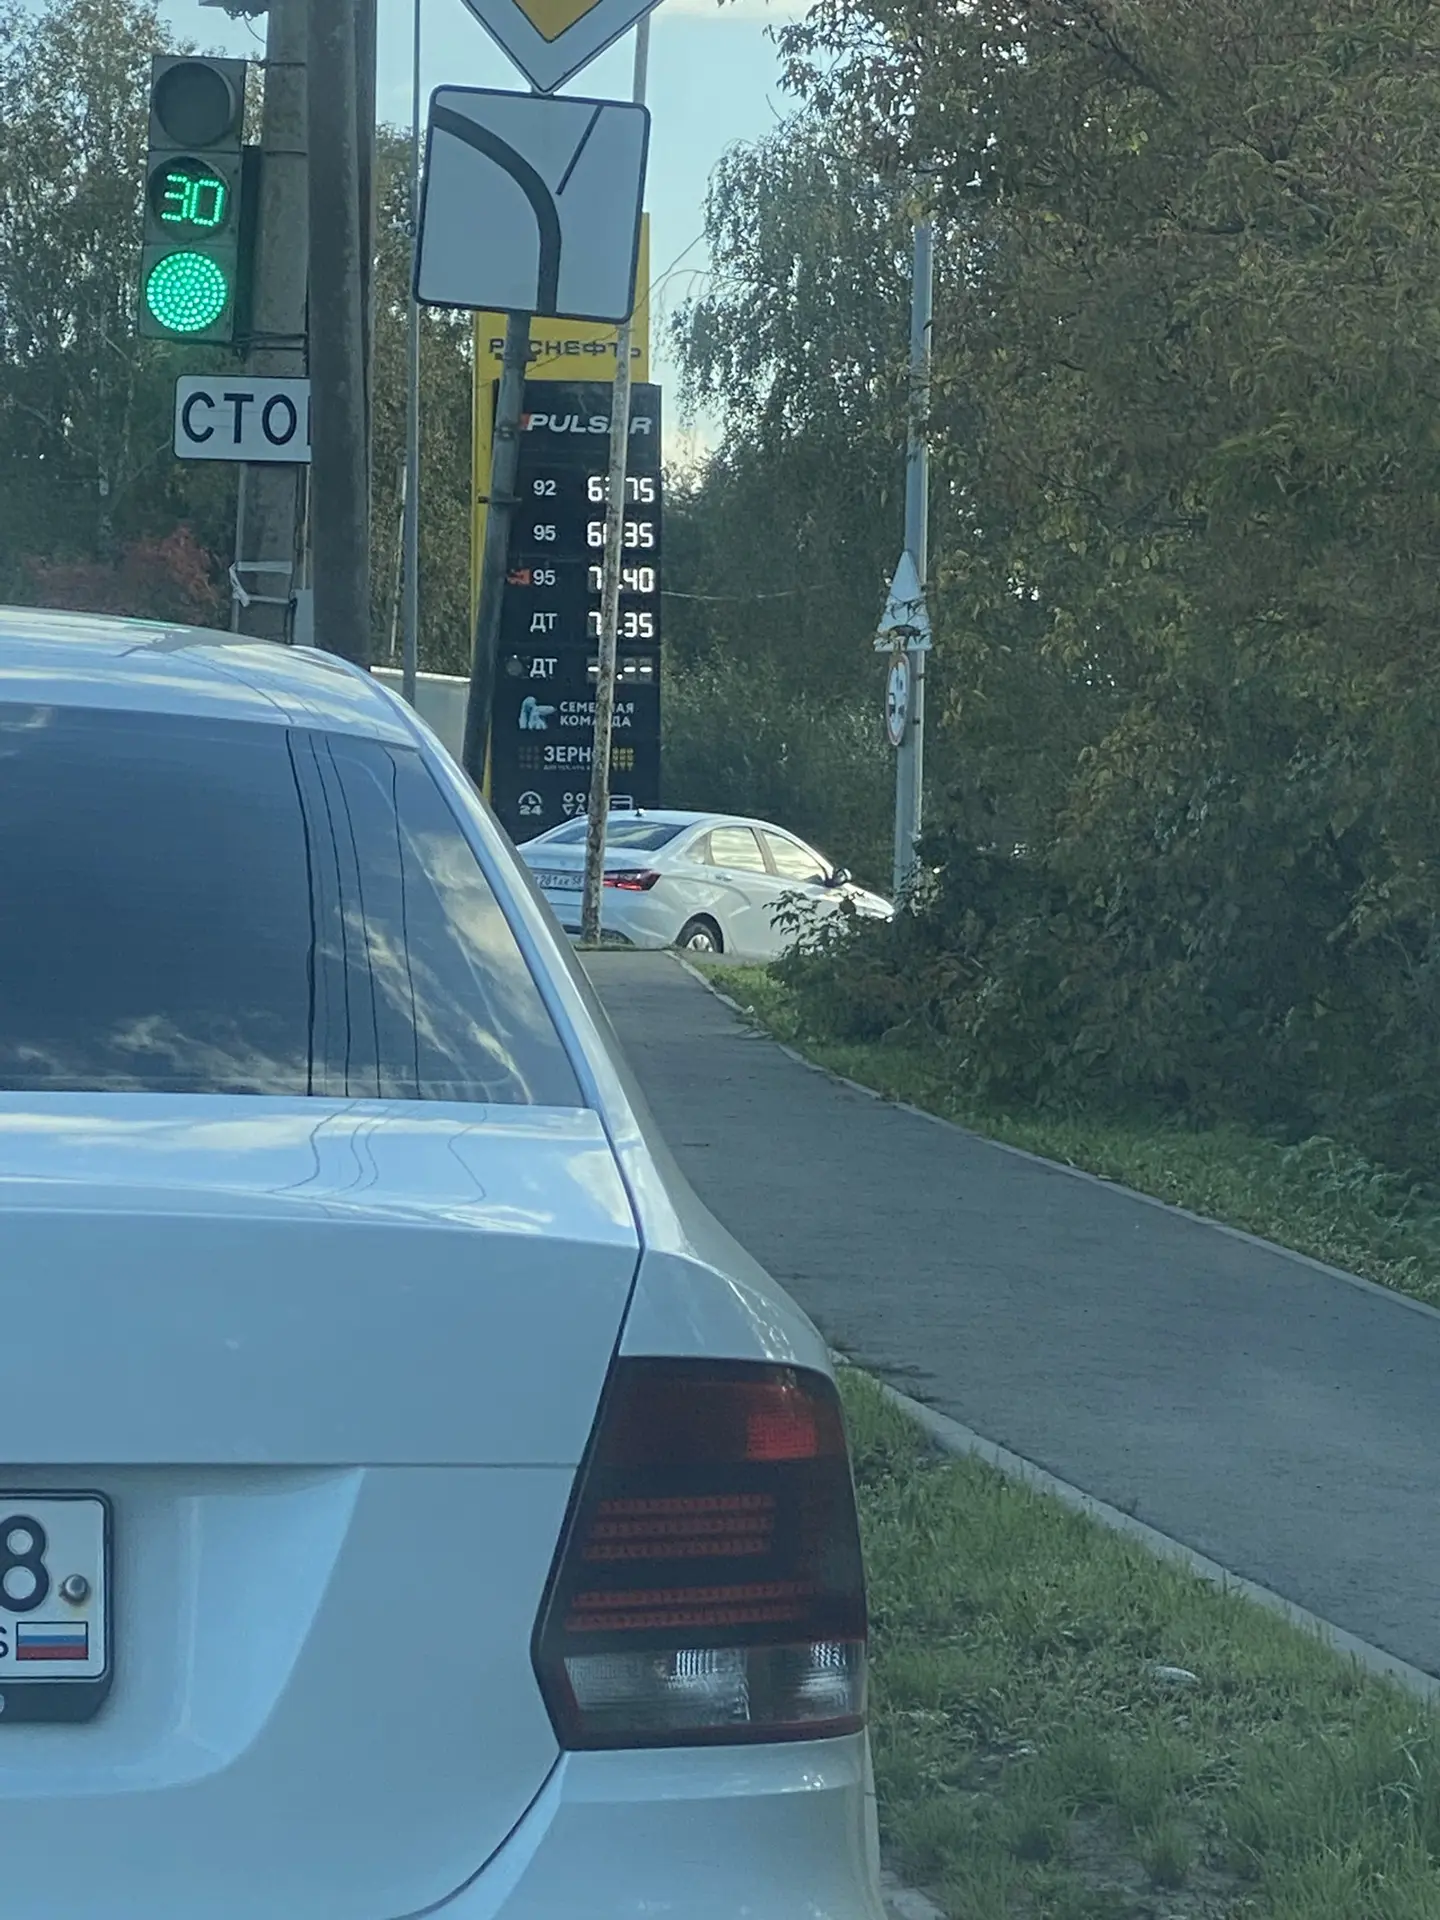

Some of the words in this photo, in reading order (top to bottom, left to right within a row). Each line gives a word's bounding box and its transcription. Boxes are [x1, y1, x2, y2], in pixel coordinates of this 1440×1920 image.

[161, 174, 225, 226] 30
[181, 391, 311, 446] СТО
[525, 413, 652, 435] PULSR
[533, 480, 557, 496] 92
[533, 525, 556, 541] 95
[532, 569, 556, 586] 95
[588, 566, 655, 593] 7.40
[530, 613, 558, 633] ДТ
[588, 611, 654, 638] 7.35
[530, 658, 558, 678] ДТ
[559, 701, 635, 714] СЕМЕАЯ
[543, 746, 597, 763] ЗЕРН
